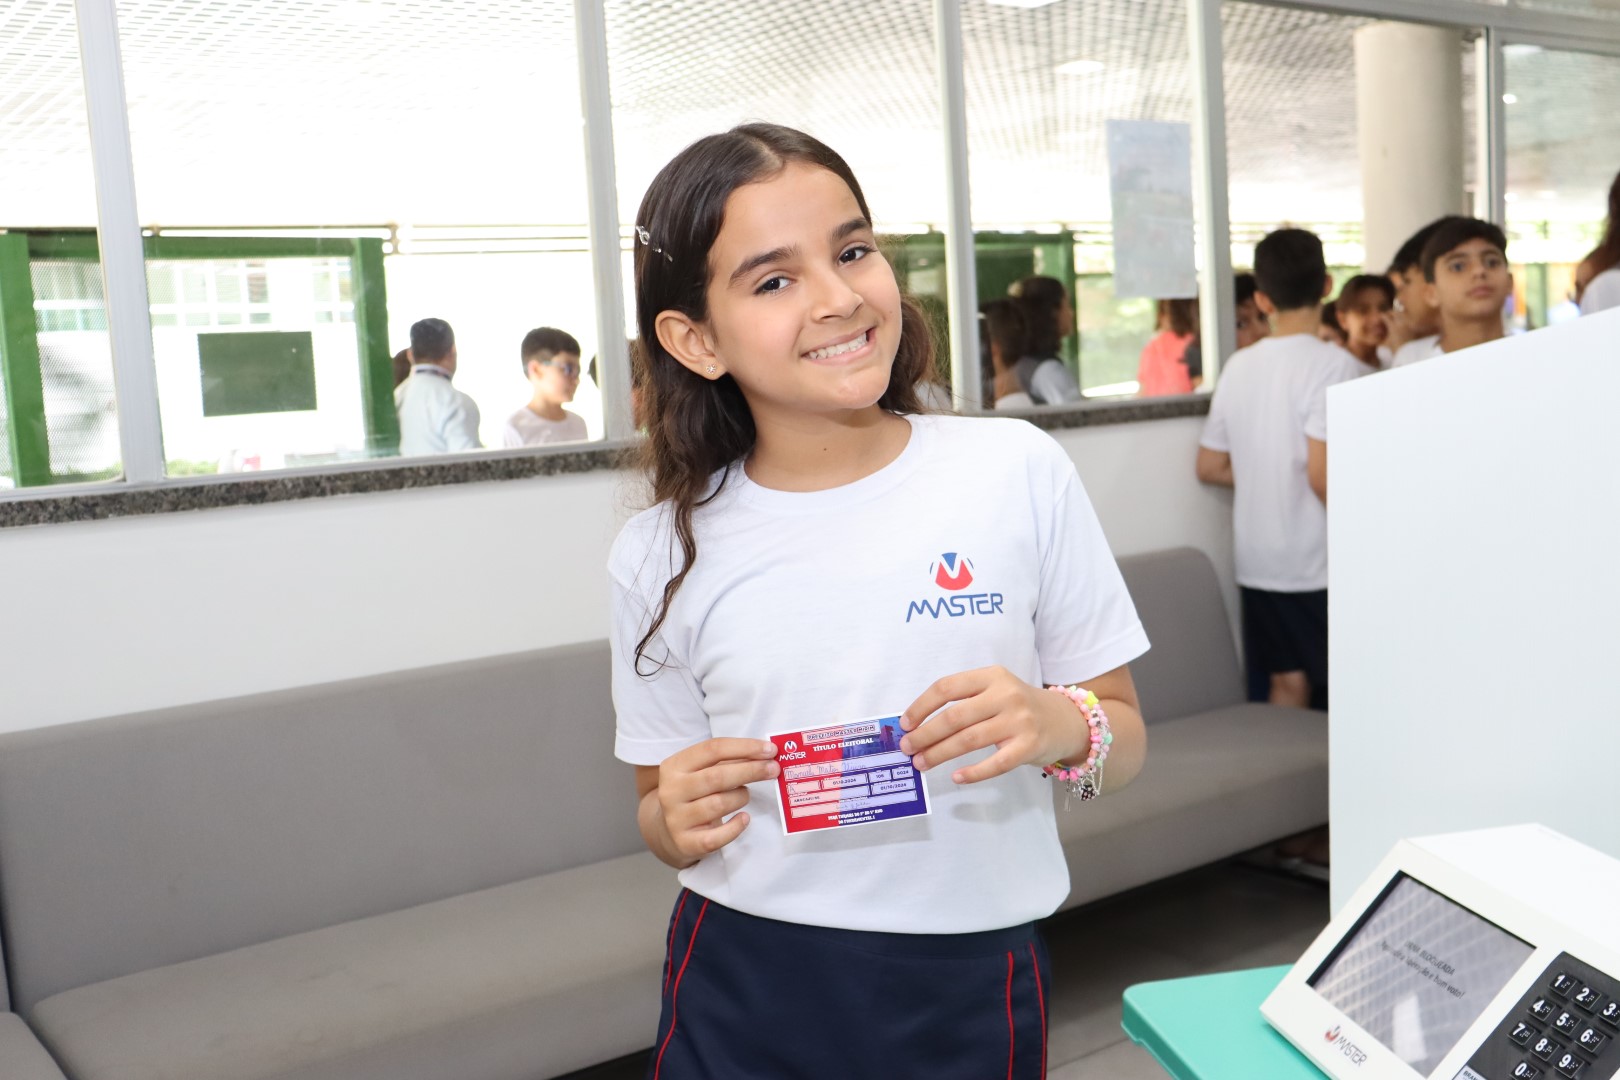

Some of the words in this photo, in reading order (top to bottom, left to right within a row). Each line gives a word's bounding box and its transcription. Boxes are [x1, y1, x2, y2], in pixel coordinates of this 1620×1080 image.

[905, 592, 1004, 623] MASTER
[779, 751, 806, 762] MASTER
[813, 743, 837, 752] TÍTULO
[838, 738, 874, 749] ELEITORAL
[880, 782, 907, 791] 01/10/2024
[1447, 984, 1466, 999] voto!
[1554, 974, 1566, 988] 1
[1575, 987, 1590, 1002] 2
[1602, 1002, 1617, 1016] 3
[1532, 999, 1545, 1013] 4
[1556, 1012, 1570, 1026] 5
[1580, 1028, 1594, 1043] 6
[1333, 1036, 1367, 1067] MASTER
[1512, 1022, 1526, 1036] 7
[1534, 1038, 1548, 1052] 8
[1558, 1054, 1572, 1068] 9
[1514, 1062, 1527, 1076] 0
